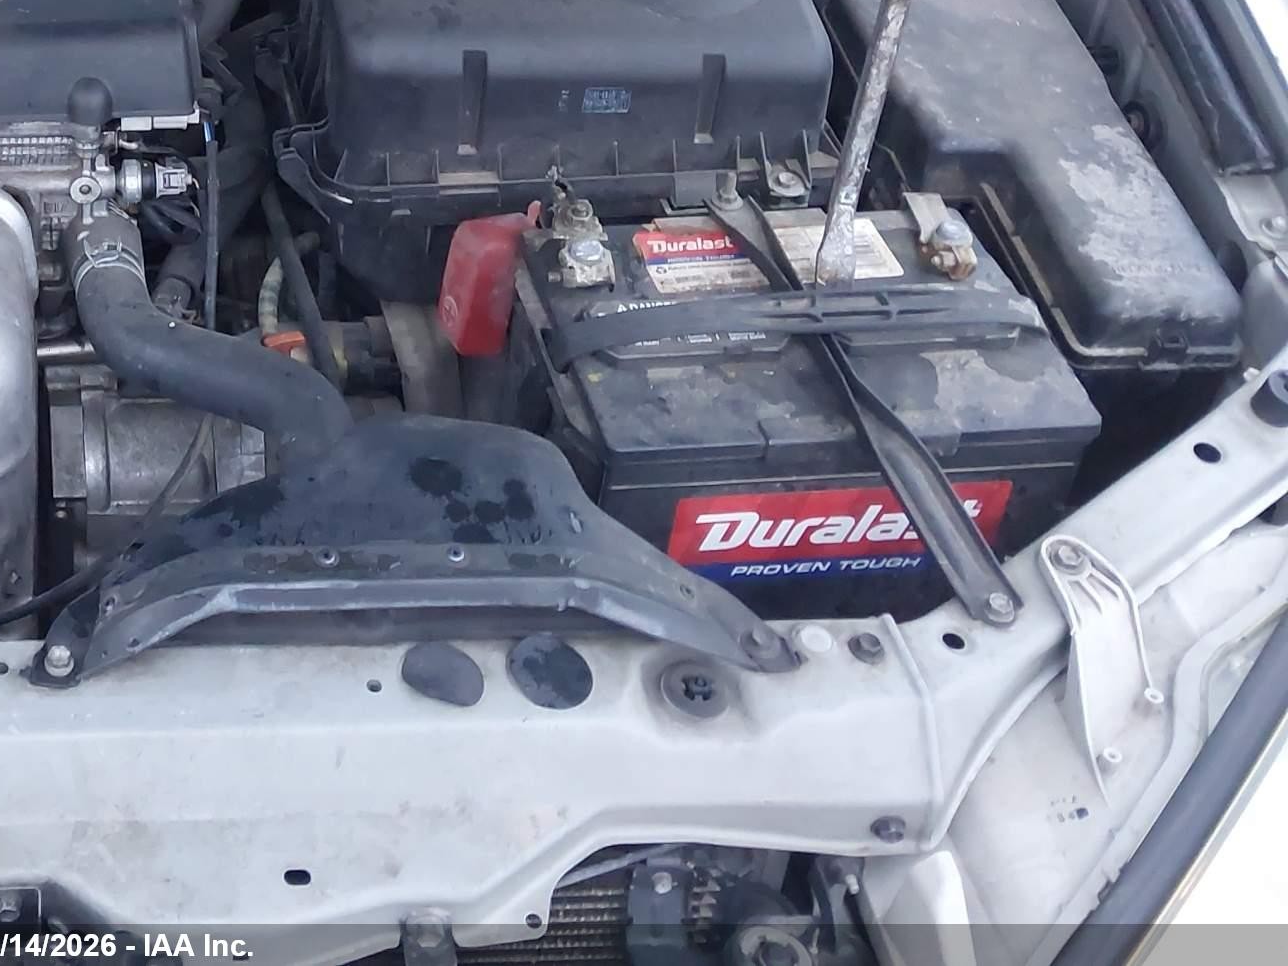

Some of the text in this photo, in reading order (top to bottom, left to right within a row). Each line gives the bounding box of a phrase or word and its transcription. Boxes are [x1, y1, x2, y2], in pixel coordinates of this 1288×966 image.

[647, 236, 734, 254] Duralast
[695, 499, 980, 552] Durala
[730, 556, 922, 577] PROVEN TOUGH
